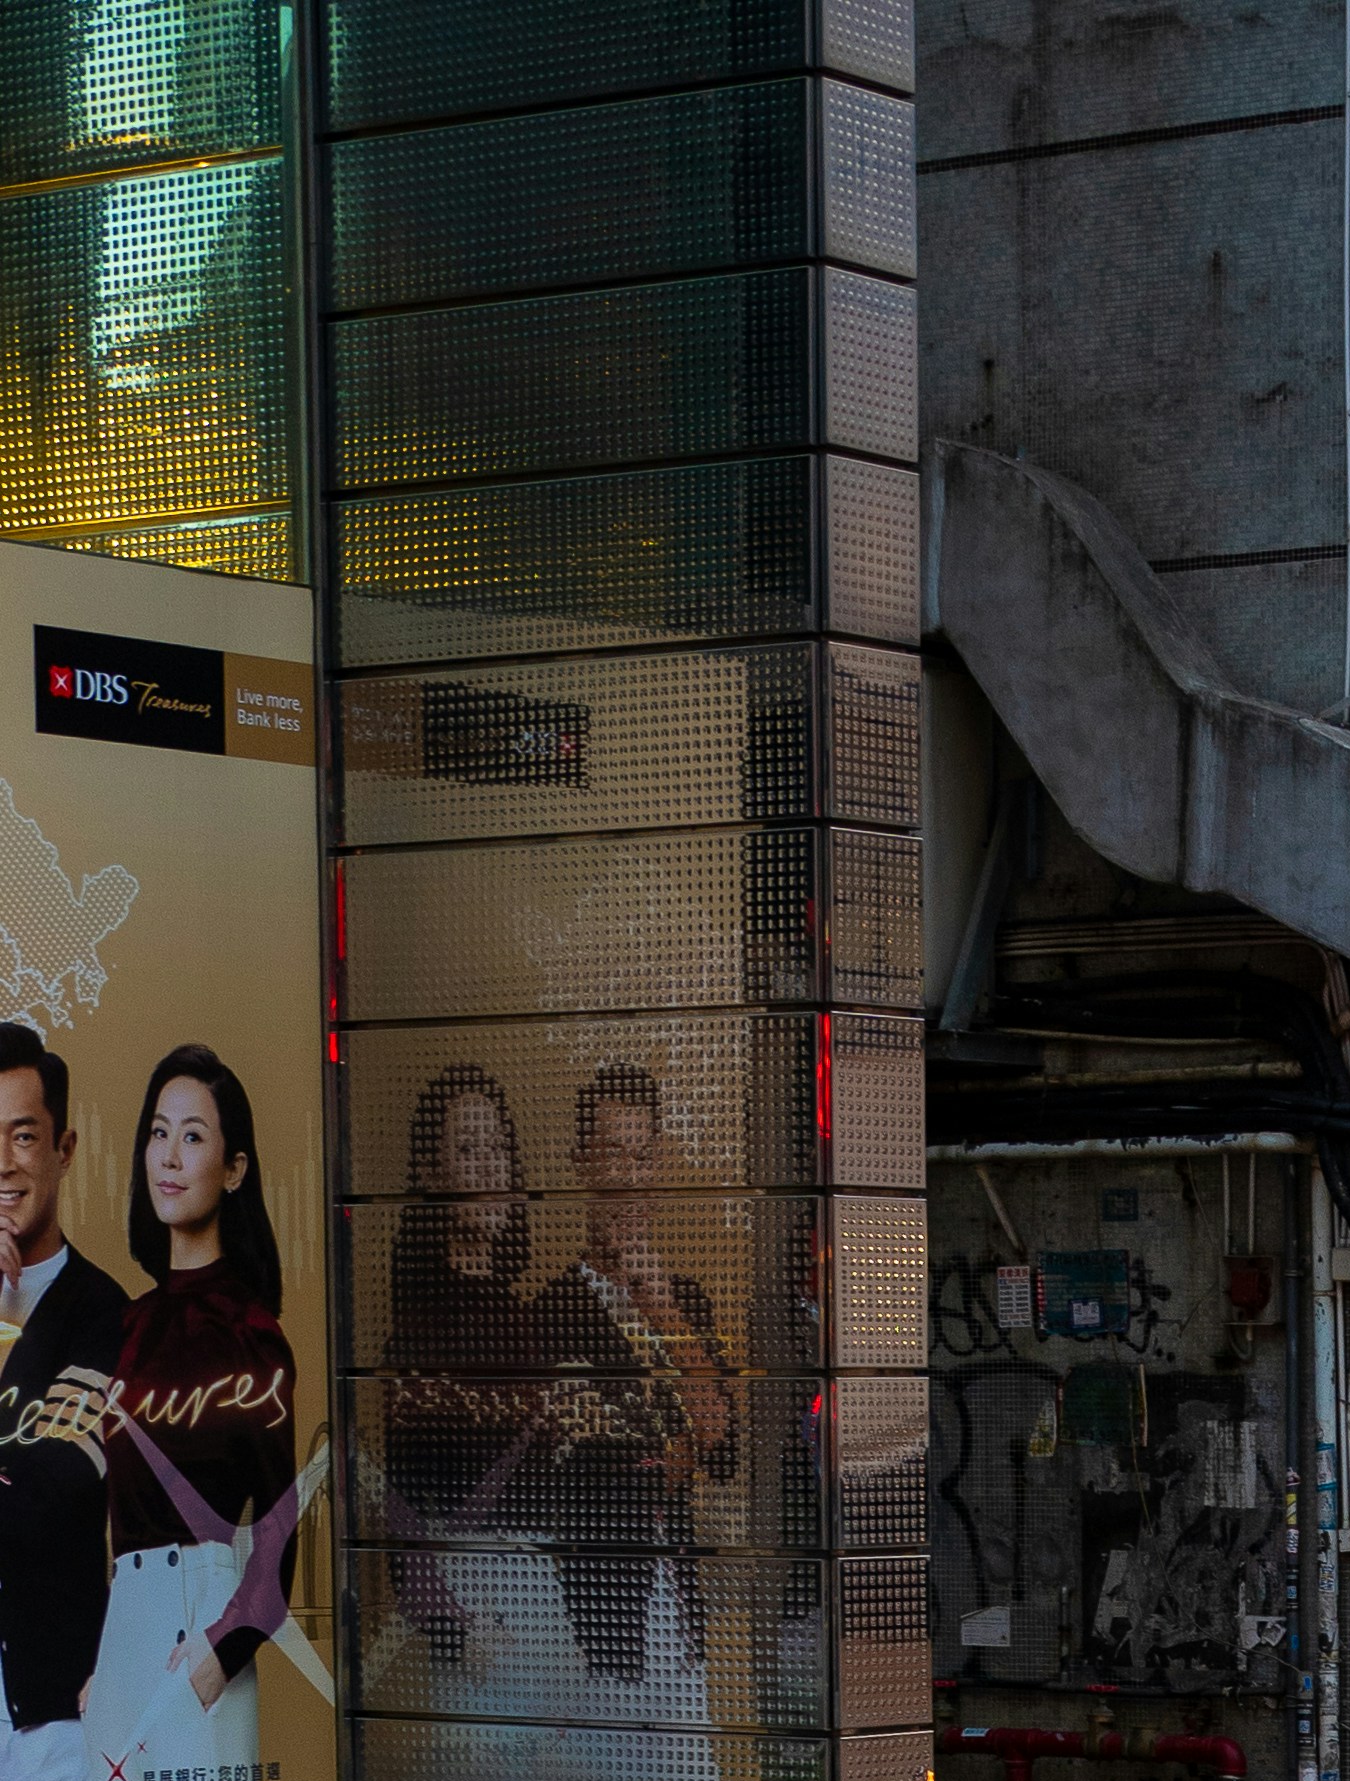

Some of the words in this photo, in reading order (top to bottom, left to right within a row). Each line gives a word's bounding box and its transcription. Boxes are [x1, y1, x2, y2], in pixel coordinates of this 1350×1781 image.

[75, 669, 129, 705] DBS
[130, 681, 212, 718] Treasures
[236, 688, 264, 706] Live
[265, 695, 304, 713] more,
[237, 708, 271, 728] Bank
[274, 713, 301, 732] less
